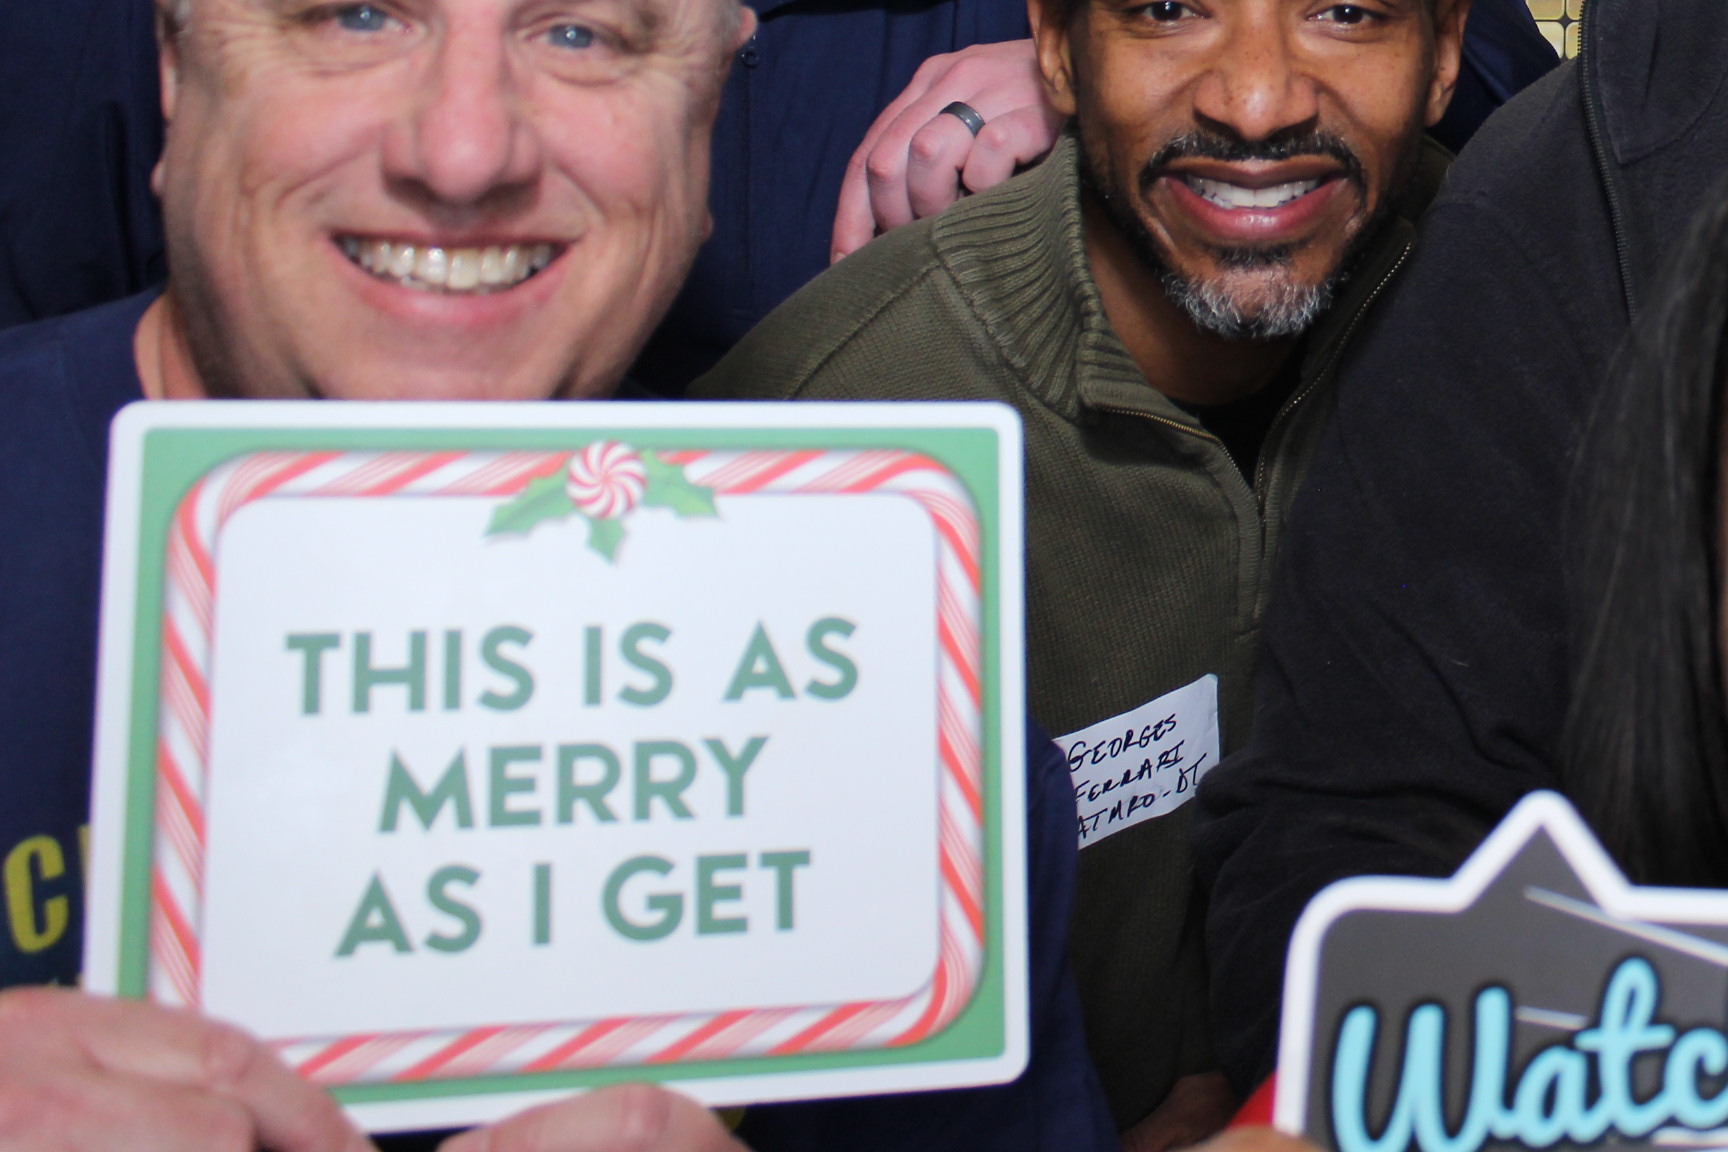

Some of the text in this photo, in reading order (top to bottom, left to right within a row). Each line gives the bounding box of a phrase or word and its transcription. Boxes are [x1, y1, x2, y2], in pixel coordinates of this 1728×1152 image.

[285, 618, 857, 716] THIS IS AS
[377, 737, 768, 835] MERRY
[1067, 713, 1177, 772] GEORGES
[335, 851, 811, 957] AS I GET
